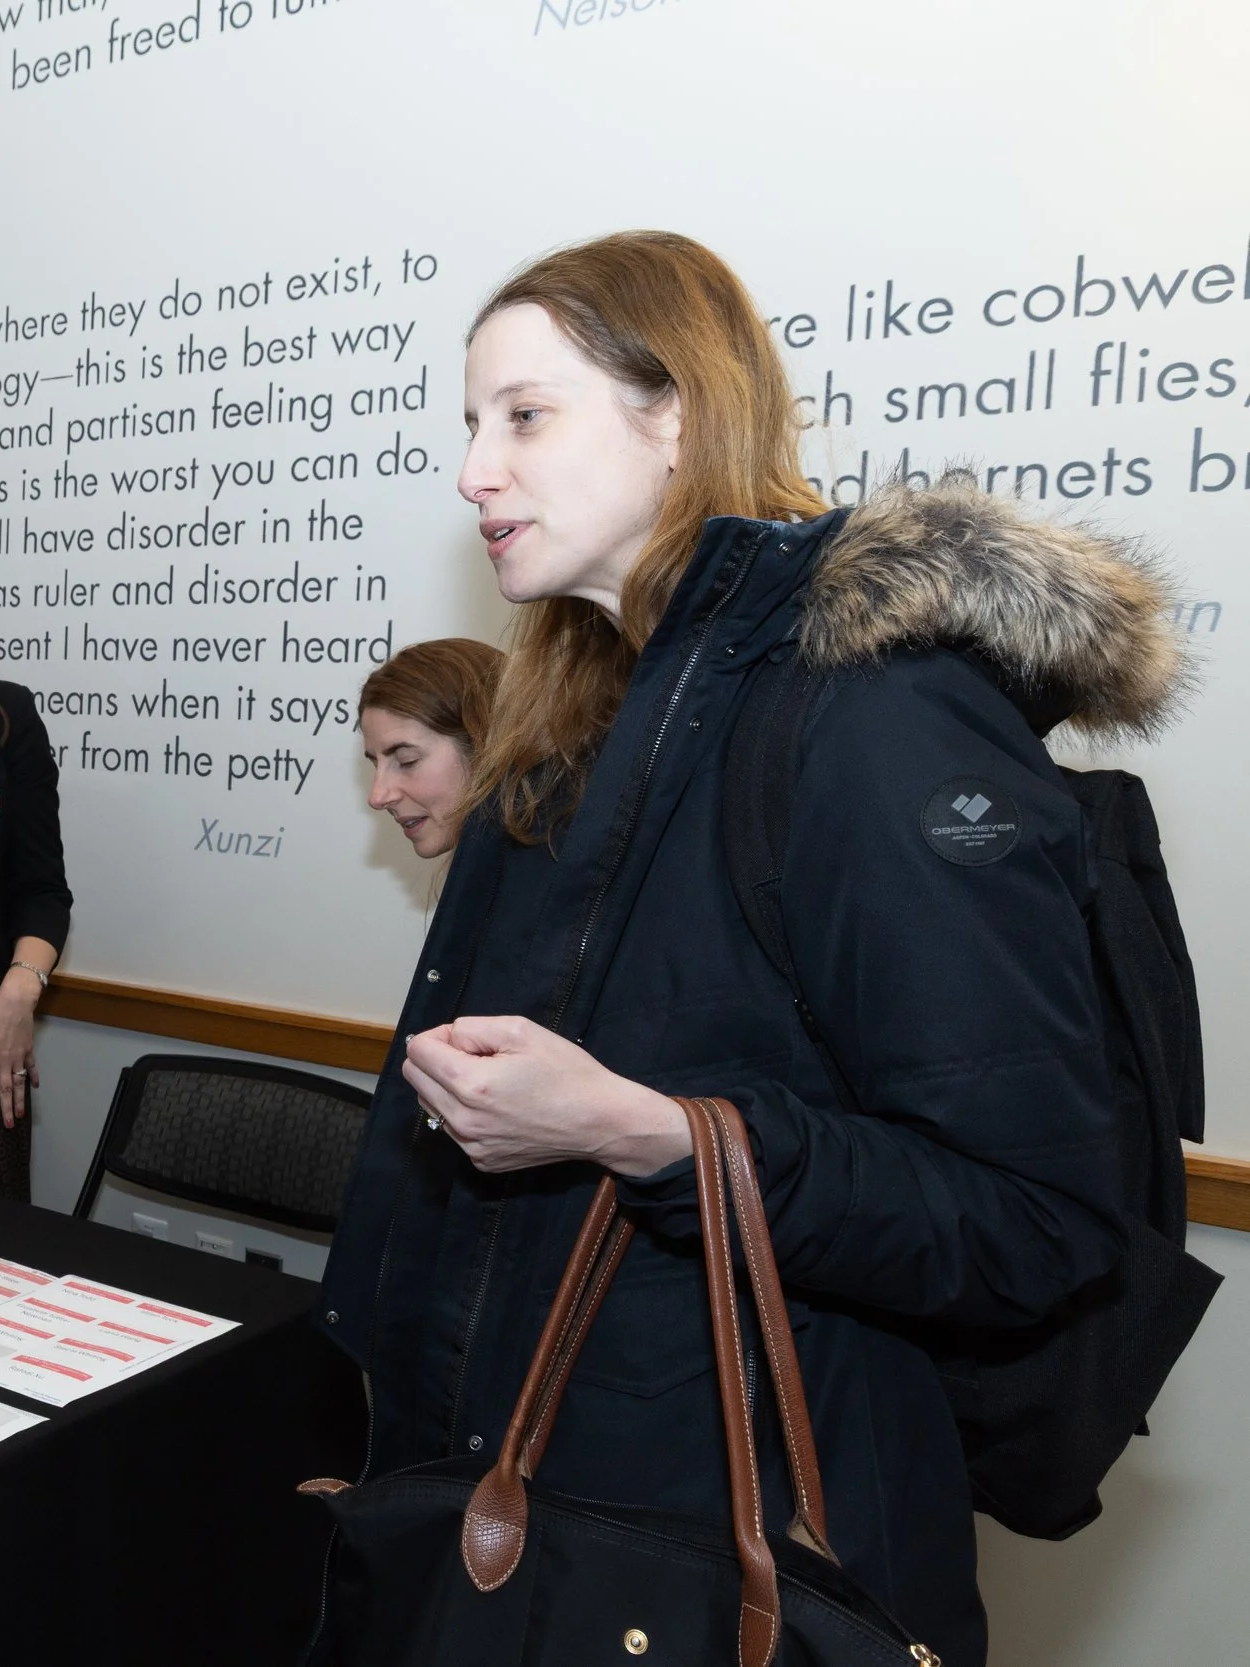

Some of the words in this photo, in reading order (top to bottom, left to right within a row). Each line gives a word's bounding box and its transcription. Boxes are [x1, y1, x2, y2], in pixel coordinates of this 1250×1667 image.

[12, 45, 91, 90] been
[108, 0, 201, 64] freed
[219, 0, 253, 32] to
[81, 291, 146, 337] they
[159, 278, 202, 319] do
[218, 272, 273, 311] not
[286, 256, 381, 301] exist,
[402, 249, 437, 284] to
[847, 279, 954, 342] like
[983, 233, 1250, 327] cobwe
[142, 345, 163, 379] is
[178, 333, 227, 375] the
[244, 325, 317, 367] best
[331, 321, 416, 362] way
[67, 403, 195, 455] partisan
[212, 382, 332, 433] feeling
[351, 365, 427, 416] and
[884, 348, 1055, 423] small
[22, 469, 41, 501] is
[54, 460, 98, 499] the
[111, 457, 199, 494] worst
[211, 460, 274, 500] you
[291, 453, 358, 482] can
[376, 431, 439, 476] do.
[23, 516, 94, 554] have
[107, 505, 246, 551] disorder
[262, 508, 290, 543] in
[308, 498, 363, 542] the
[34, 569, 100, 607] ruler
[112, 565, 174, 606] and
[188, 560, 338, 605] disorder
[356, 564, 386, 601] in
[64, 626, 68, 660] I
[83, 622, 157, 661] have
[173, 638, 267, 662] never
[282, 620, 392, 663] heard
[131, 678, 219, 719] when
[238, 685, 256, 720] it
[81, 731, 148, 773] from
[164, 735, 213, 777] the
[228, 749, 314, 795] petty
[194, 819, 284, 857] Xunzi
[932, 823, 1015, 835] OBERMEYER
